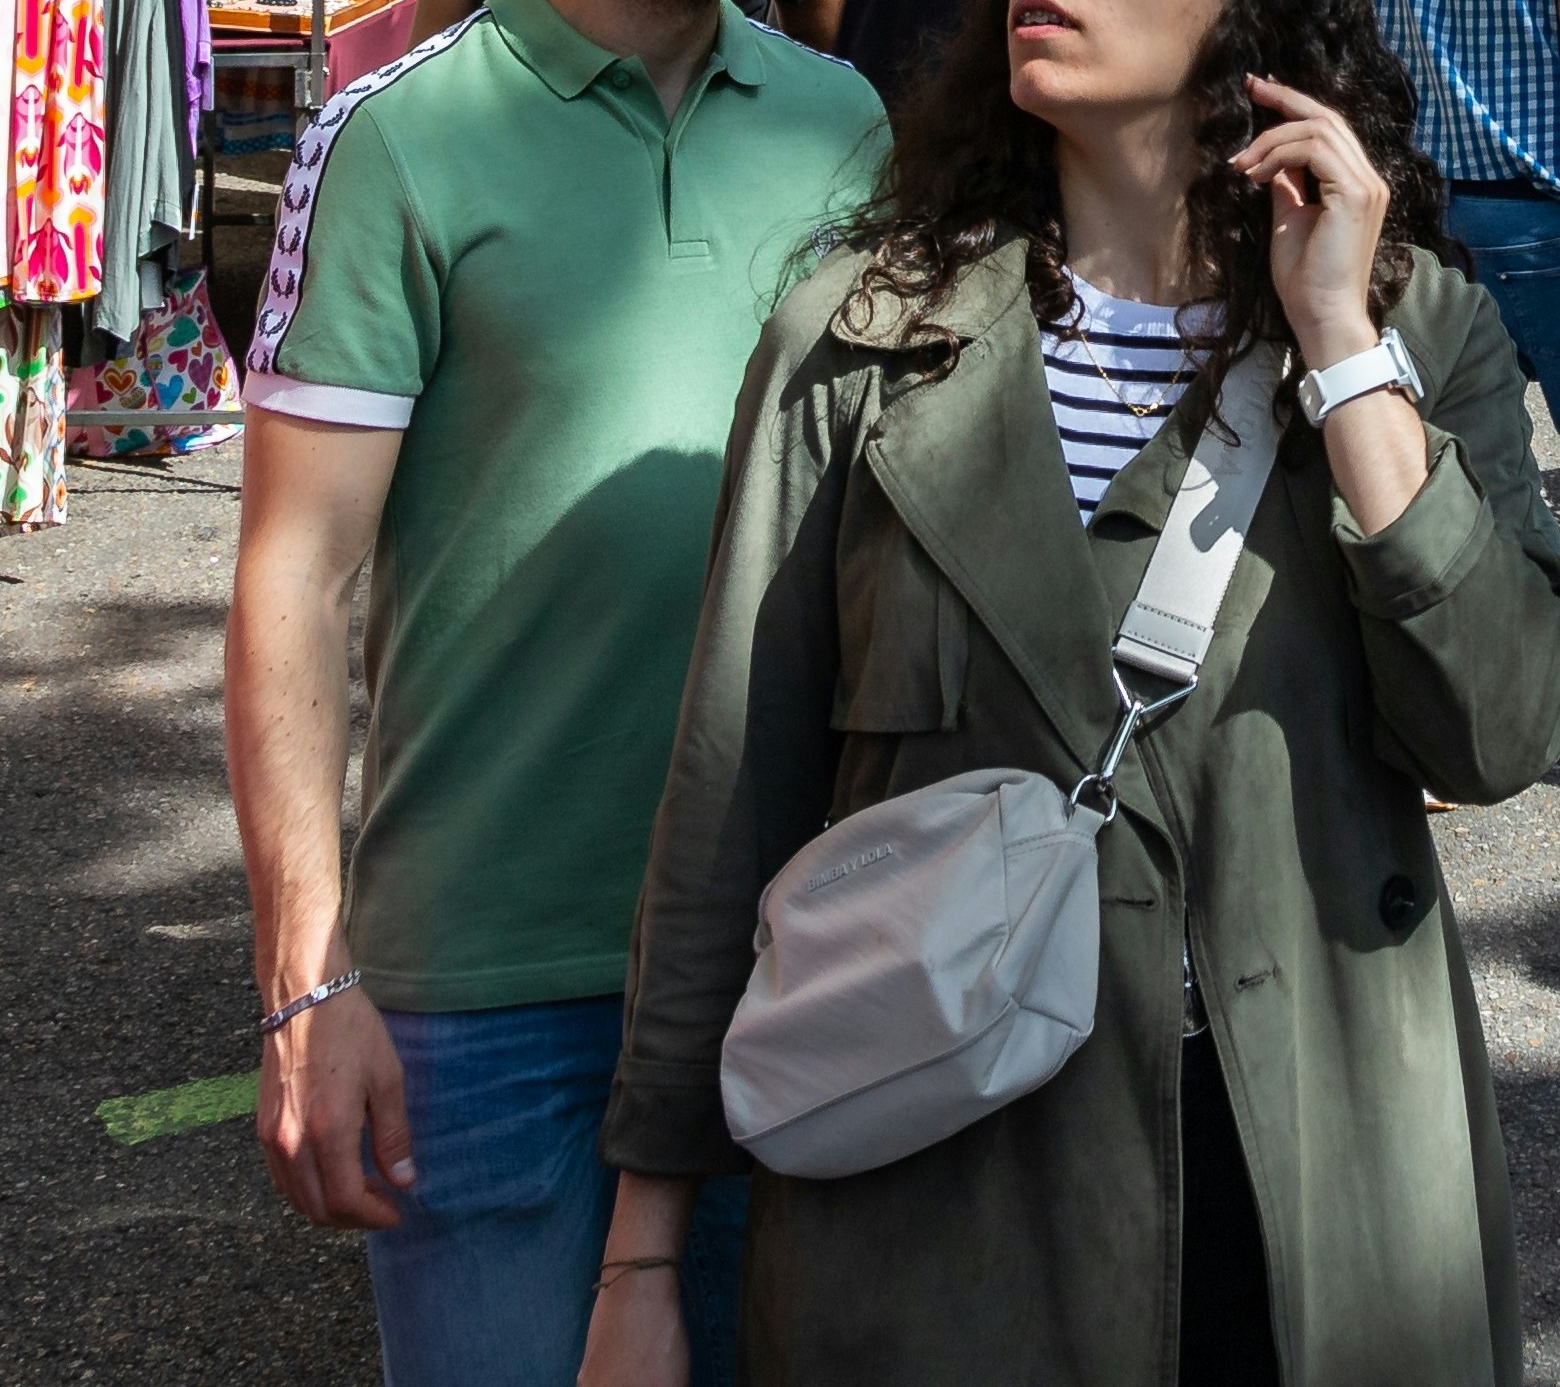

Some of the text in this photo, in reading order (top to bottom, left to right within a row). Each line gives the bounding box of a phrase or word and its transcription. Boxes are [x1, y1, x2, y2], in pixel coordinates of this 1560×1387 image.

[807, 843, 894, 892] BIMBA Y LOLA
